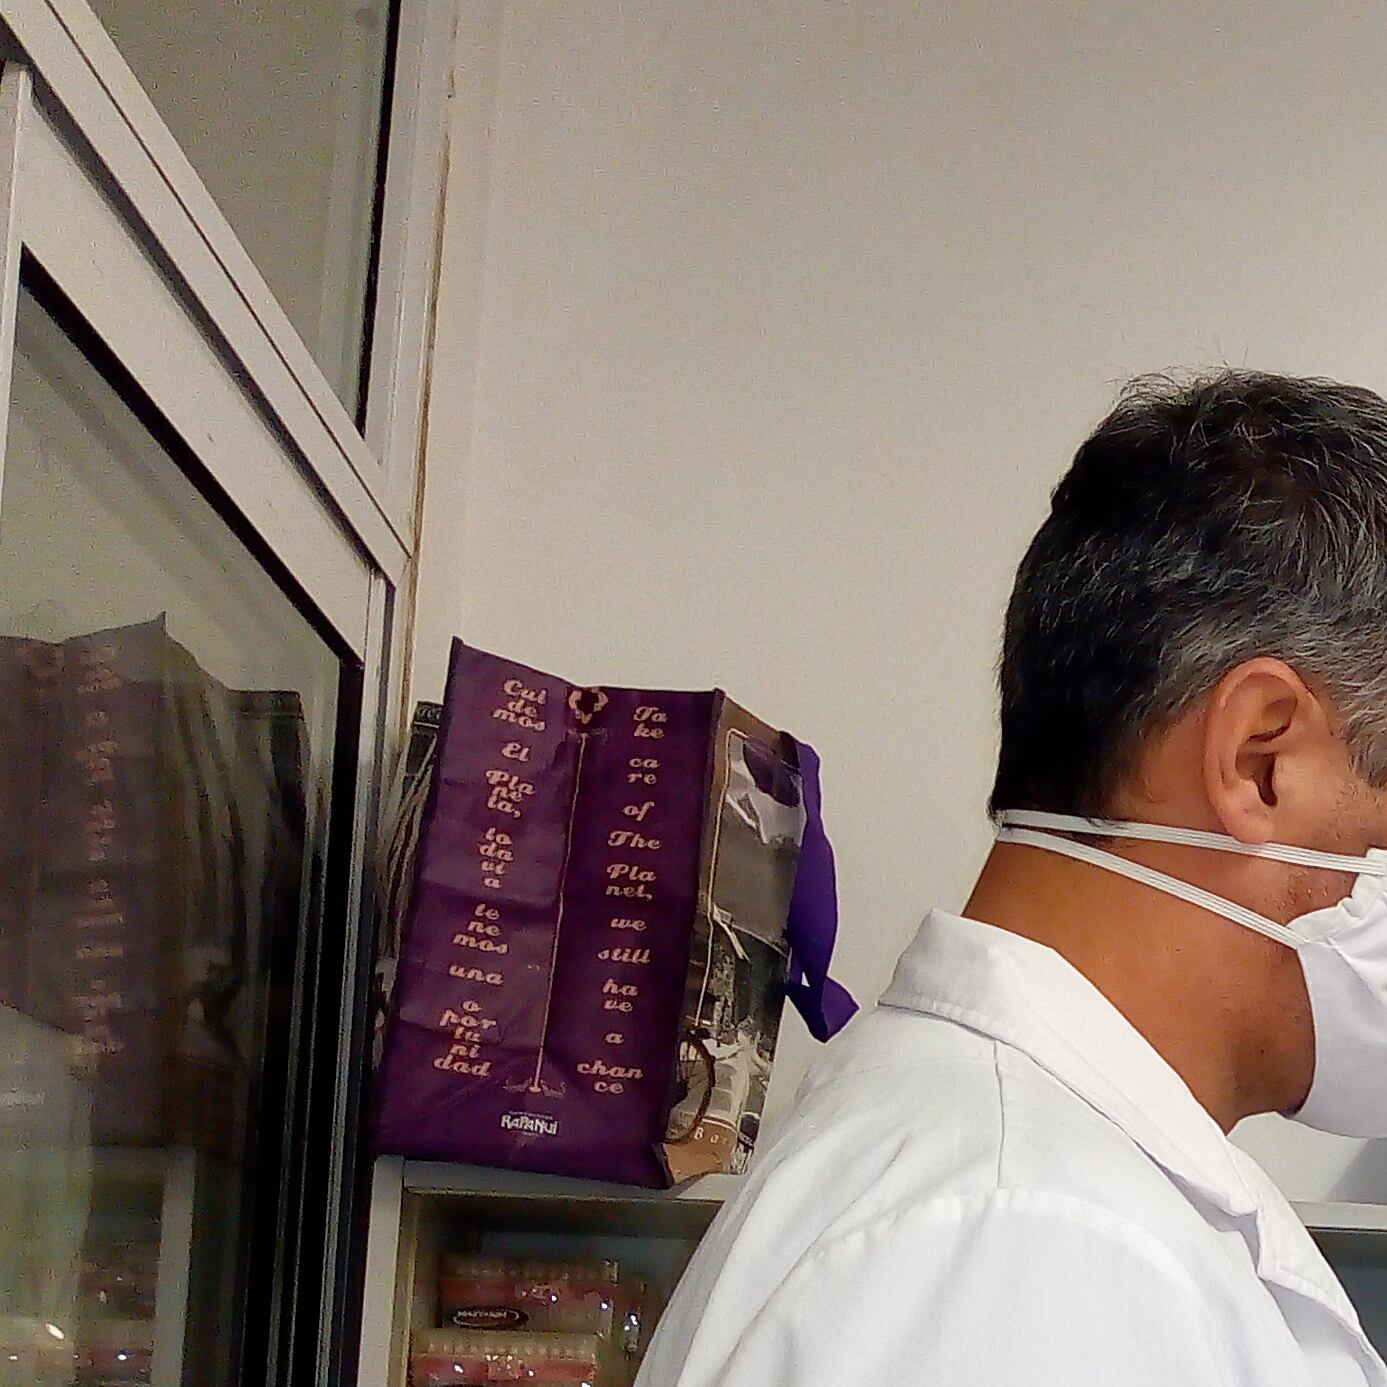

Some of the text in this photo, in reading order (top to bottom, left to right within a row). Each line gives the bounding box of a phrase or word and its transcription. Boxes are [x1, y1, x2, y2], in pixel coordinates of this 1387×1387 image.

[507, 700, 538, 718] de
[633, 706, 669, 723] Ta
[491, 709, 547, 731] mos
[633, 722, 665, 739] ke
[502, 742, 531, 762] El
[629, 757, 661, 769] ca
[485, 768, 536, 795] Pla
[627, 772, 658, 785] re
[622, 801, 655, 821] of
[607, 830, 662, 850] The
[479, 841, 514, 862] da
[607, 863, 657, 882] Pla
[484, 877, 501, 889] a
[475, 903, 500, 920] te
[468, 920, 501, 936] ne
[611, 917, 648, 931] we
[452, 933, 508, 954] mos
[598, 948, 651, 964] still
[449, 964, 504, 985] una
[602, 978, 638, 996] ha
[463, 1000, 482, 1012] o
[604, 1000, 634, 1013] ve
[439, 1009, 497, 1029] por
[605, 1033, 624, 1044] a
[451, 1044, 481, 1058] ni
[433, 1054, 492, 1077] dad
[576, 1060, 643, 1079] chan
[594, 1081, 624, 1094] ce
